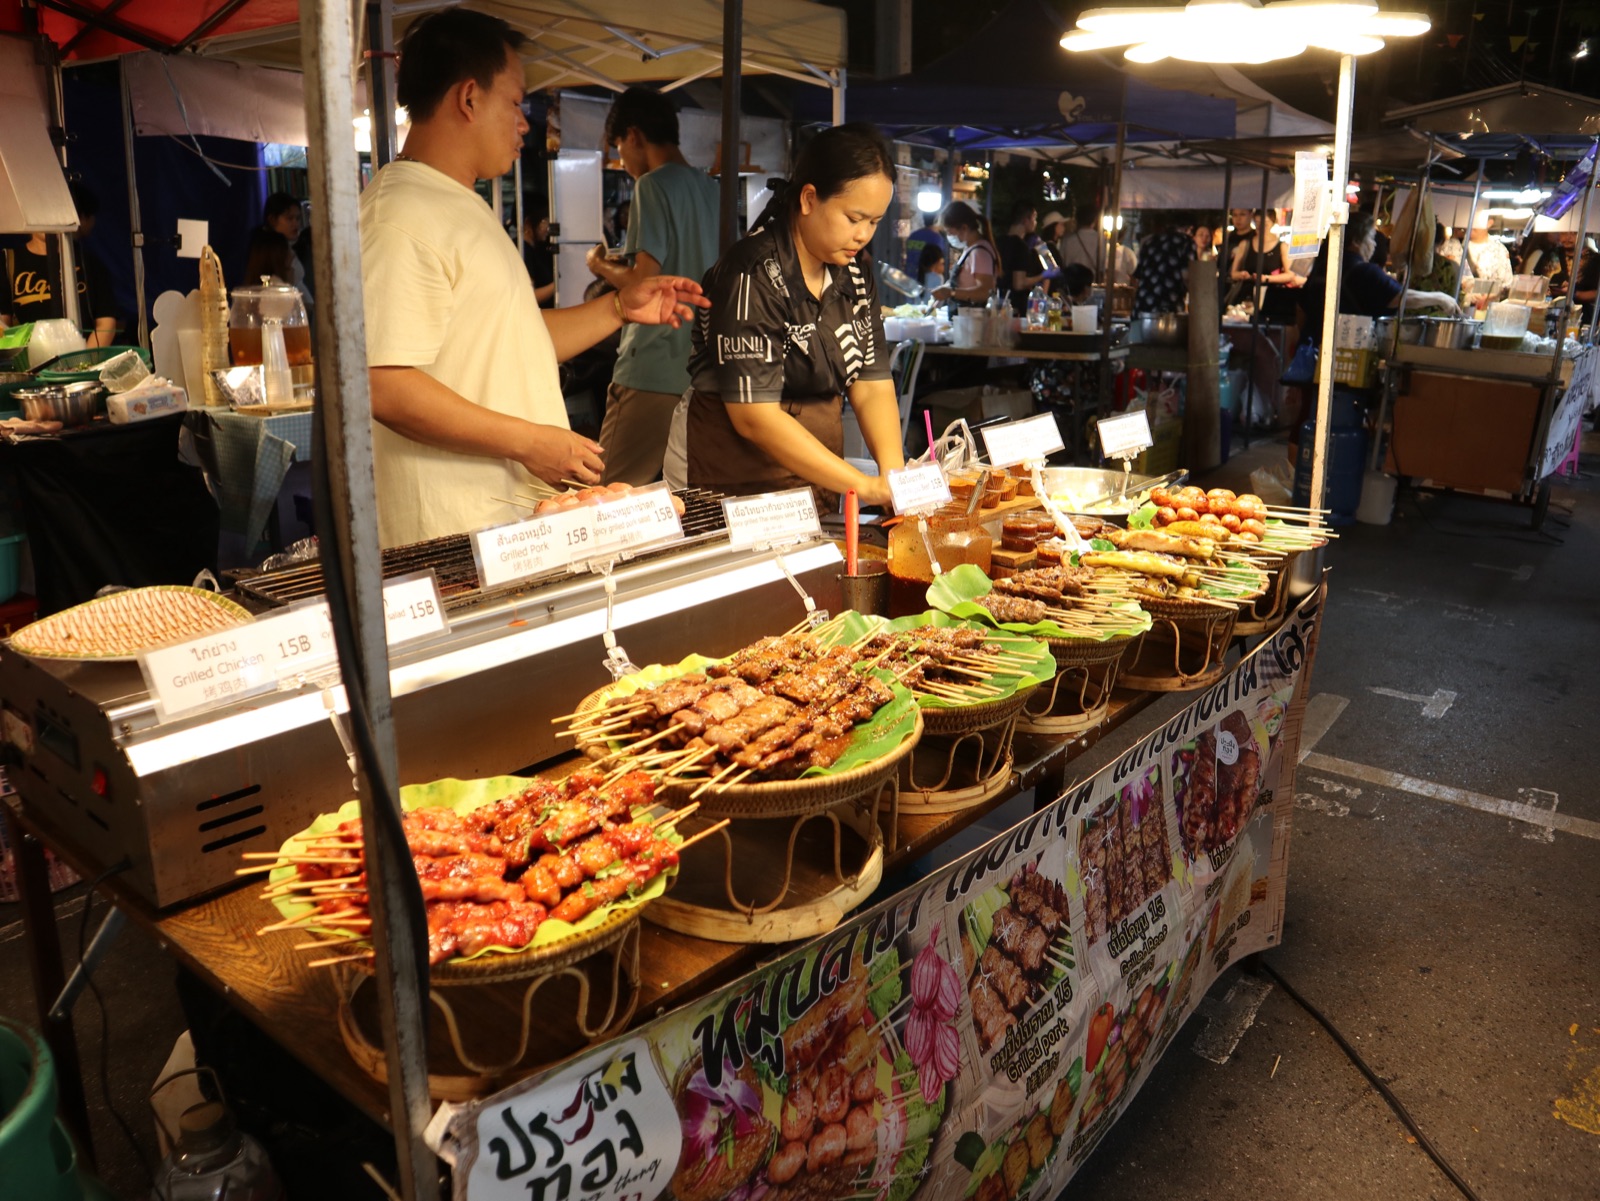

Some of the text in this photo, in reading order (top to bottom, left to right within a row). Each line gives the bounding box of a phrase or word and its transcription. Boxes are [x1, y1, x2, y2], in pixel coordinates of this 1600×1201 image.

[592, 527, 607, 538] Spicy
[609, 522, 625, 534] grilled
[500, 541, 550, 563] Grilled Pork
[190, 639, 237, 663] ไก่ย่าง
[172, 651, 265, 689] Grilled Chicken
[1148, 894, 1166, 925] 15
[1054, 976, 1073, 1012] 15
[1006, 1018, 1070, 1083] Grilled pork
[613, 1157, 662, 1194] thong
